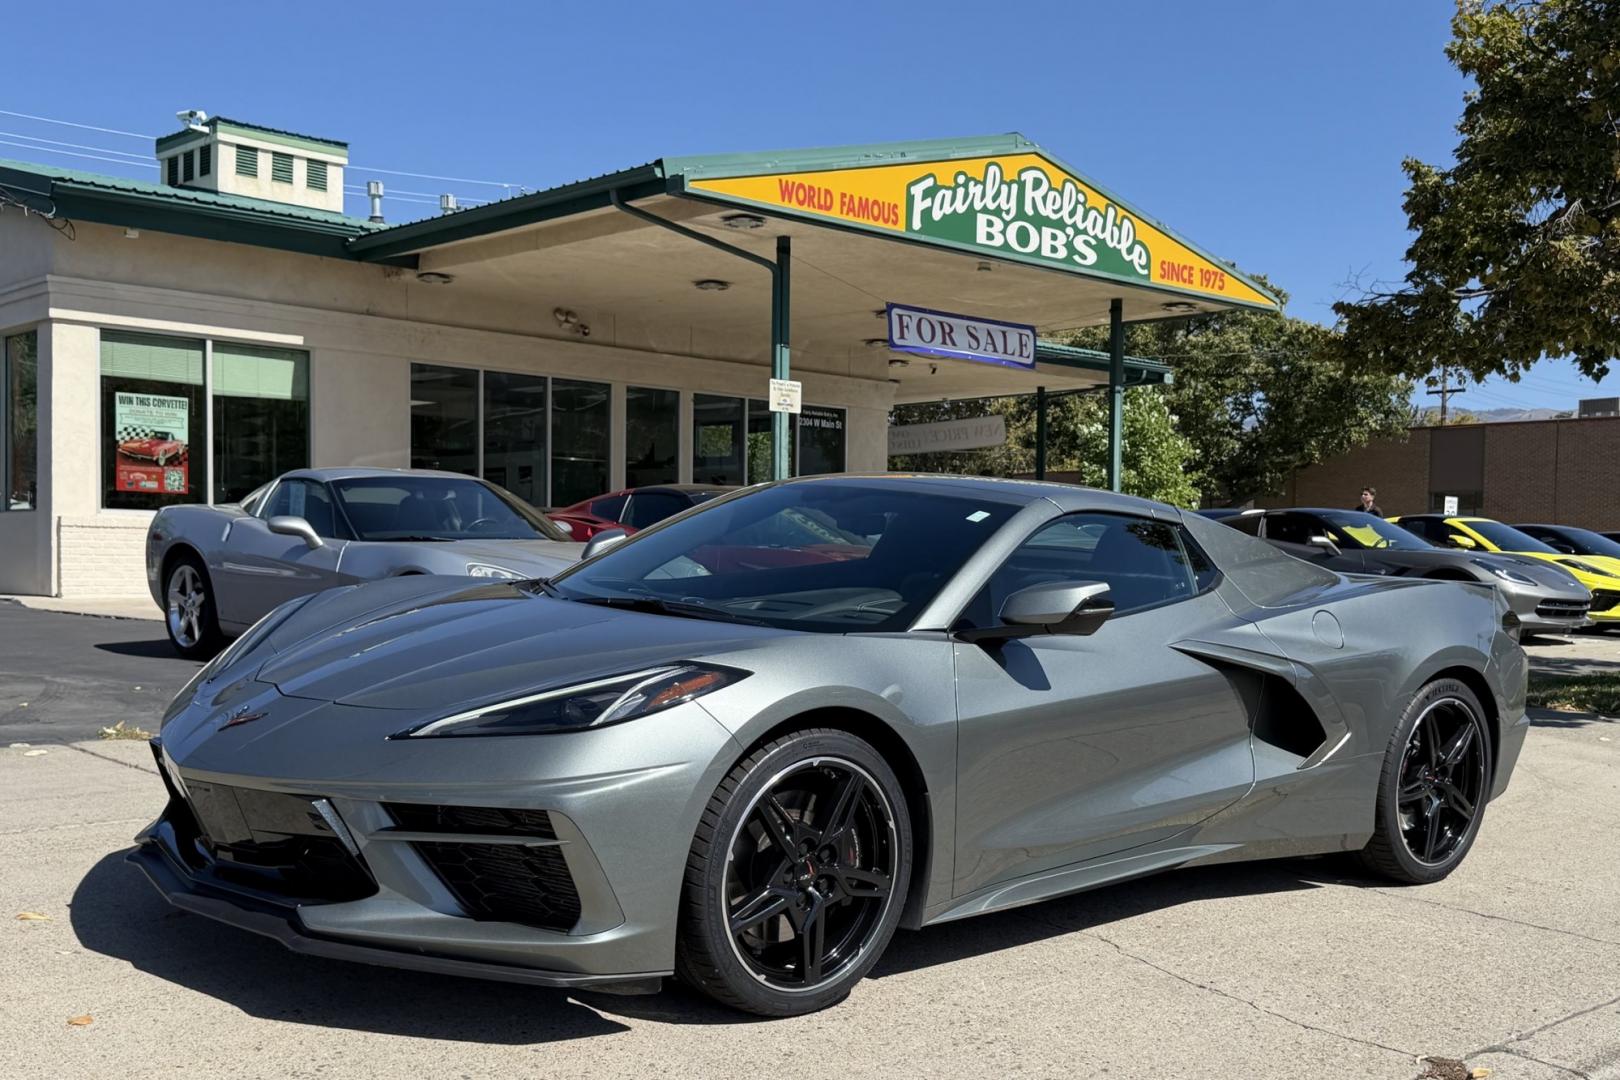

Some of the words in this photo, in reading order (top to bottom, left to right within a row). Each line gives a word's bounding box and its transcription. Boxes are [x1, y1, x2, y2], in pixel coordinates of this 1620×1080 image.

[778, 178, 834, 212] WORLD
[840, 192, 899, 226] FAMOUS
[909, 164, 1018, 231] Fairly
[1020, 169, 1149, 275] Reliable
[976, 212, 1098, 266] BOB'S
[1160, 260, 1194, 285] SINCE
[1199, 267, 1225, 291] 1975
[896, 313, 958, 347] FOR
[965, 325, 1031, 359] SALE
[118, 395, 134, 405] WIN
[136, 396, 152, 408] THIS
[152, 397, 188, 410] CORVETTE!
[799, 417, 813, 427] 2304
[813, 418, 820, 428] W
[820, 418, 835, 429] Main
[835, 420, 842, 430] St
